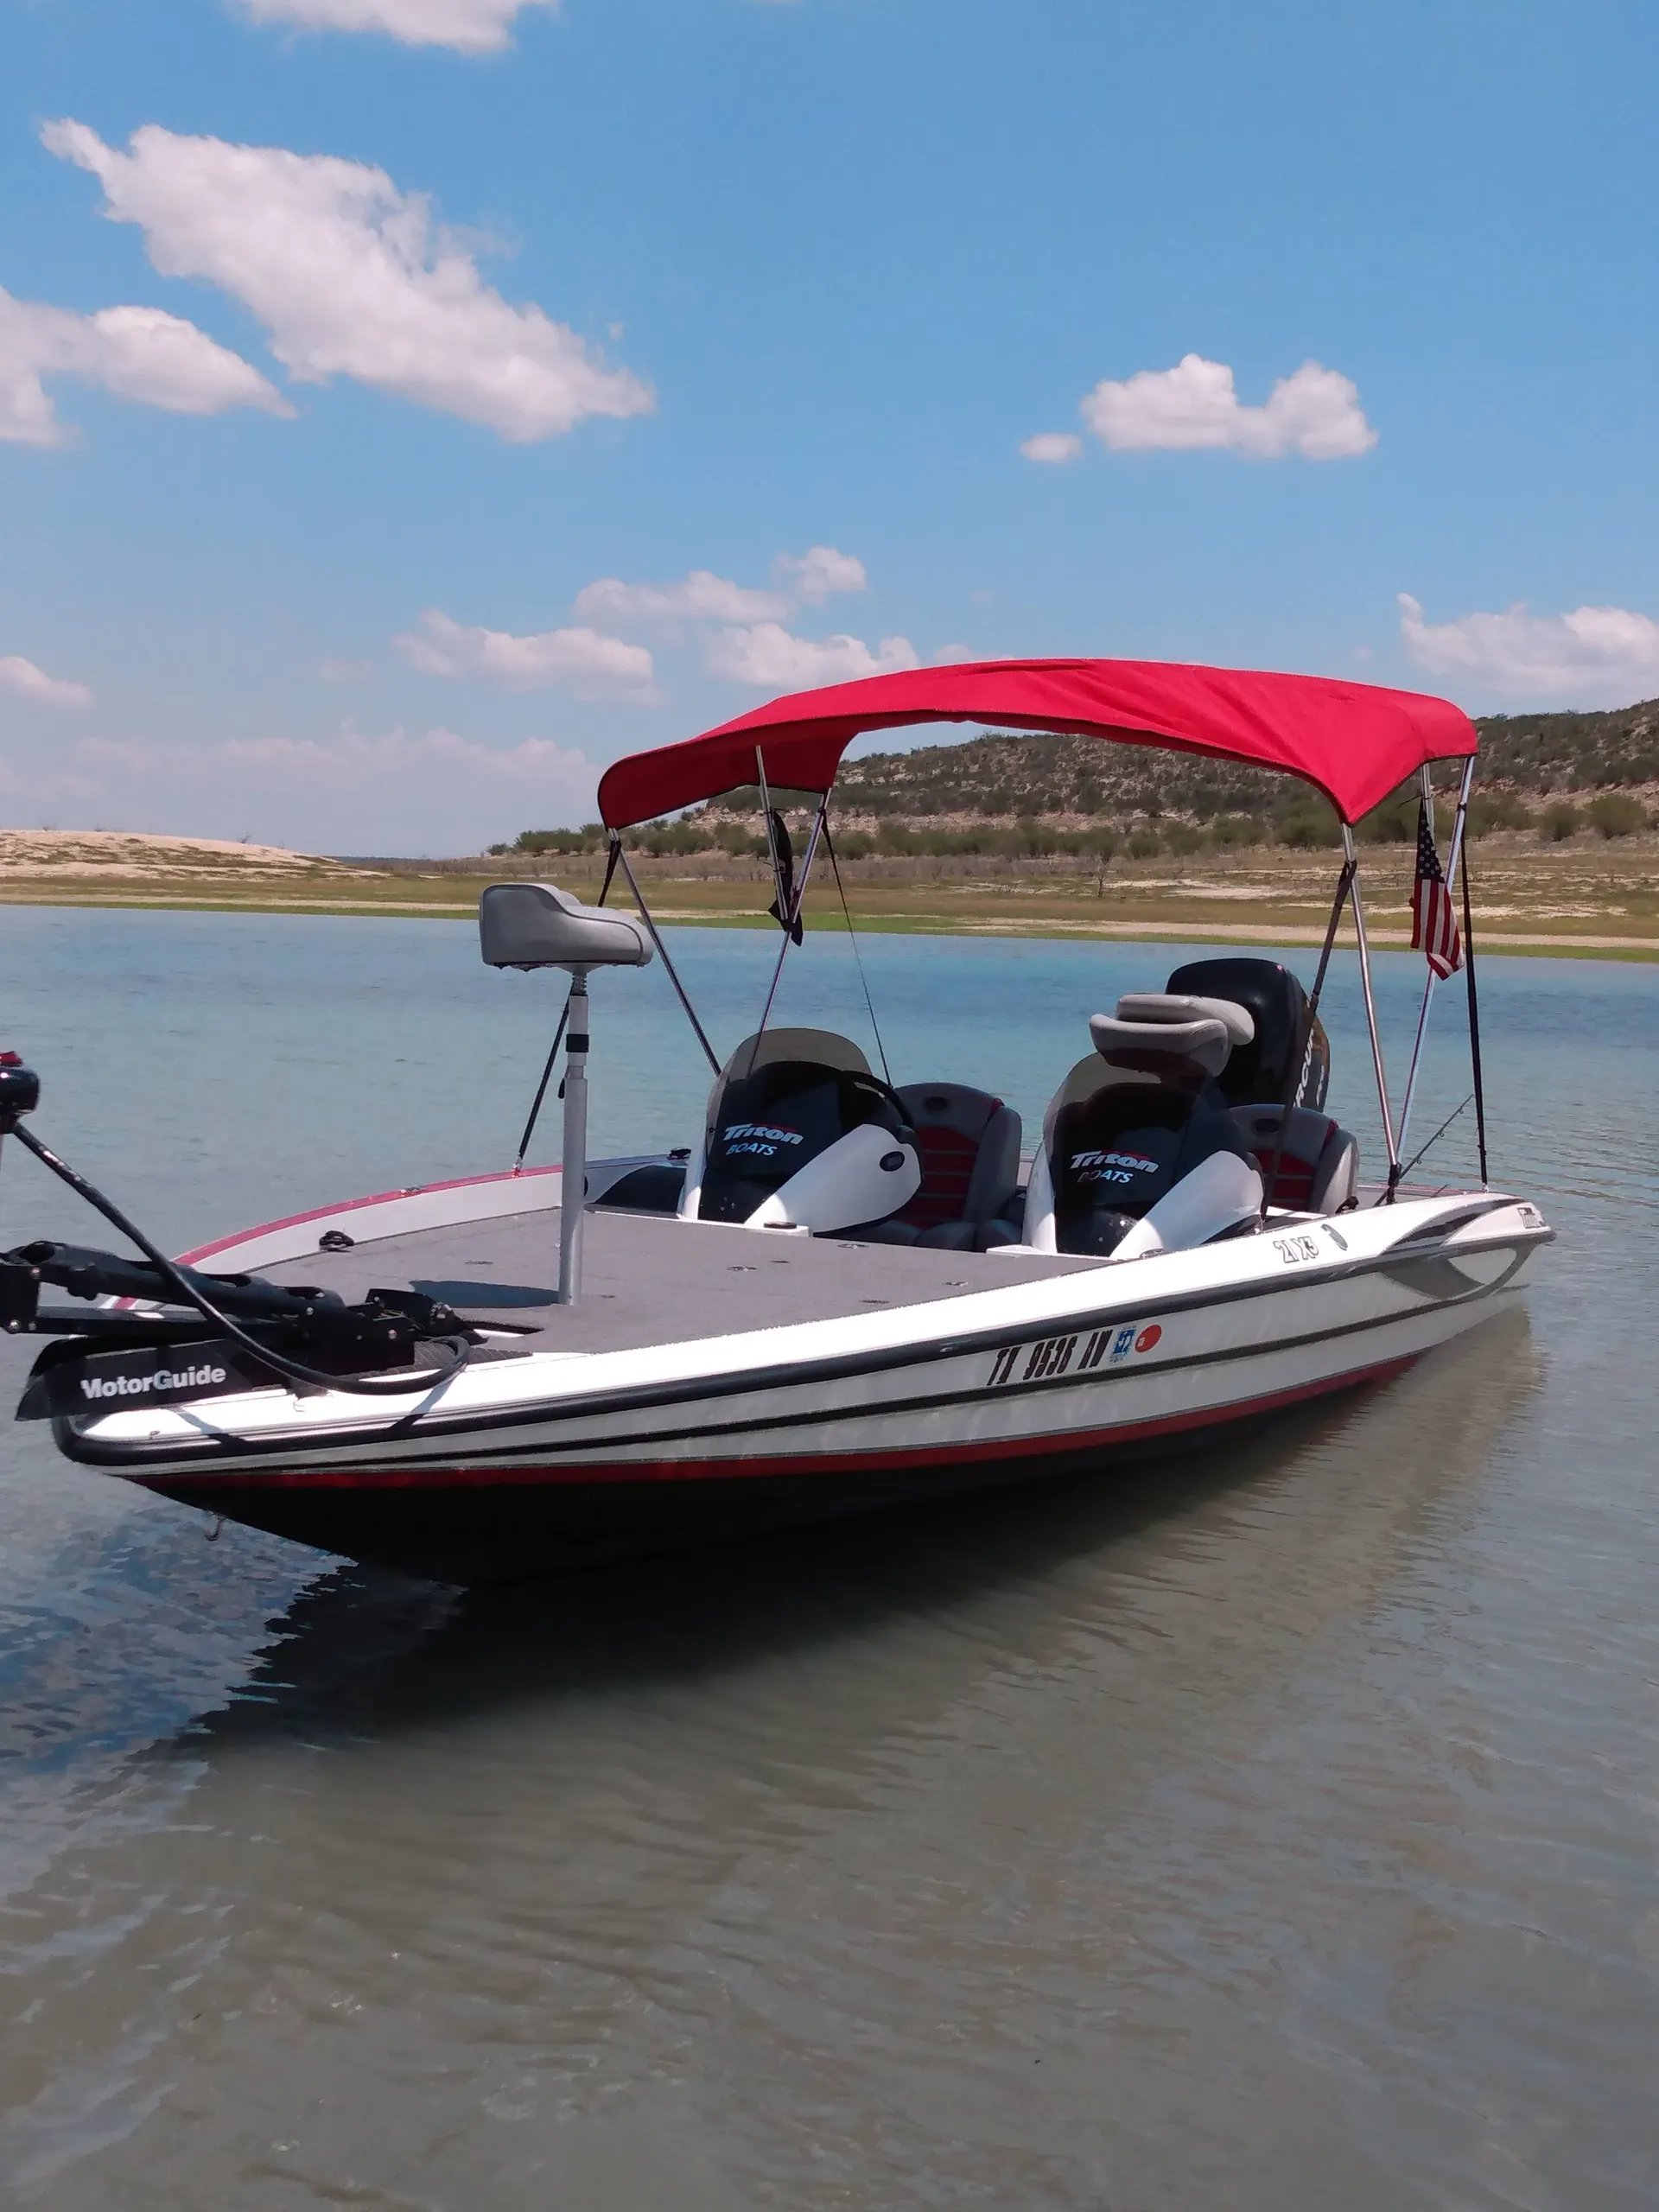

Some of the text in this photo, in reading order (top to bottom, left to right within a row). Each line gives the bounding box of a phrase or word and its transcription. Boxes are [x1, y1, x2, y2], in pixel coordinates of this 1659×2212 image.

[723, 1123, 804, 1145] Triton
[725, 1142, 778, 1156] BOATS
[1070, 1150, 1160, 1173] Triton
[986, 1346, 1021, 1385] TX
[80, 1365, 226, 1399] MotorGuide
